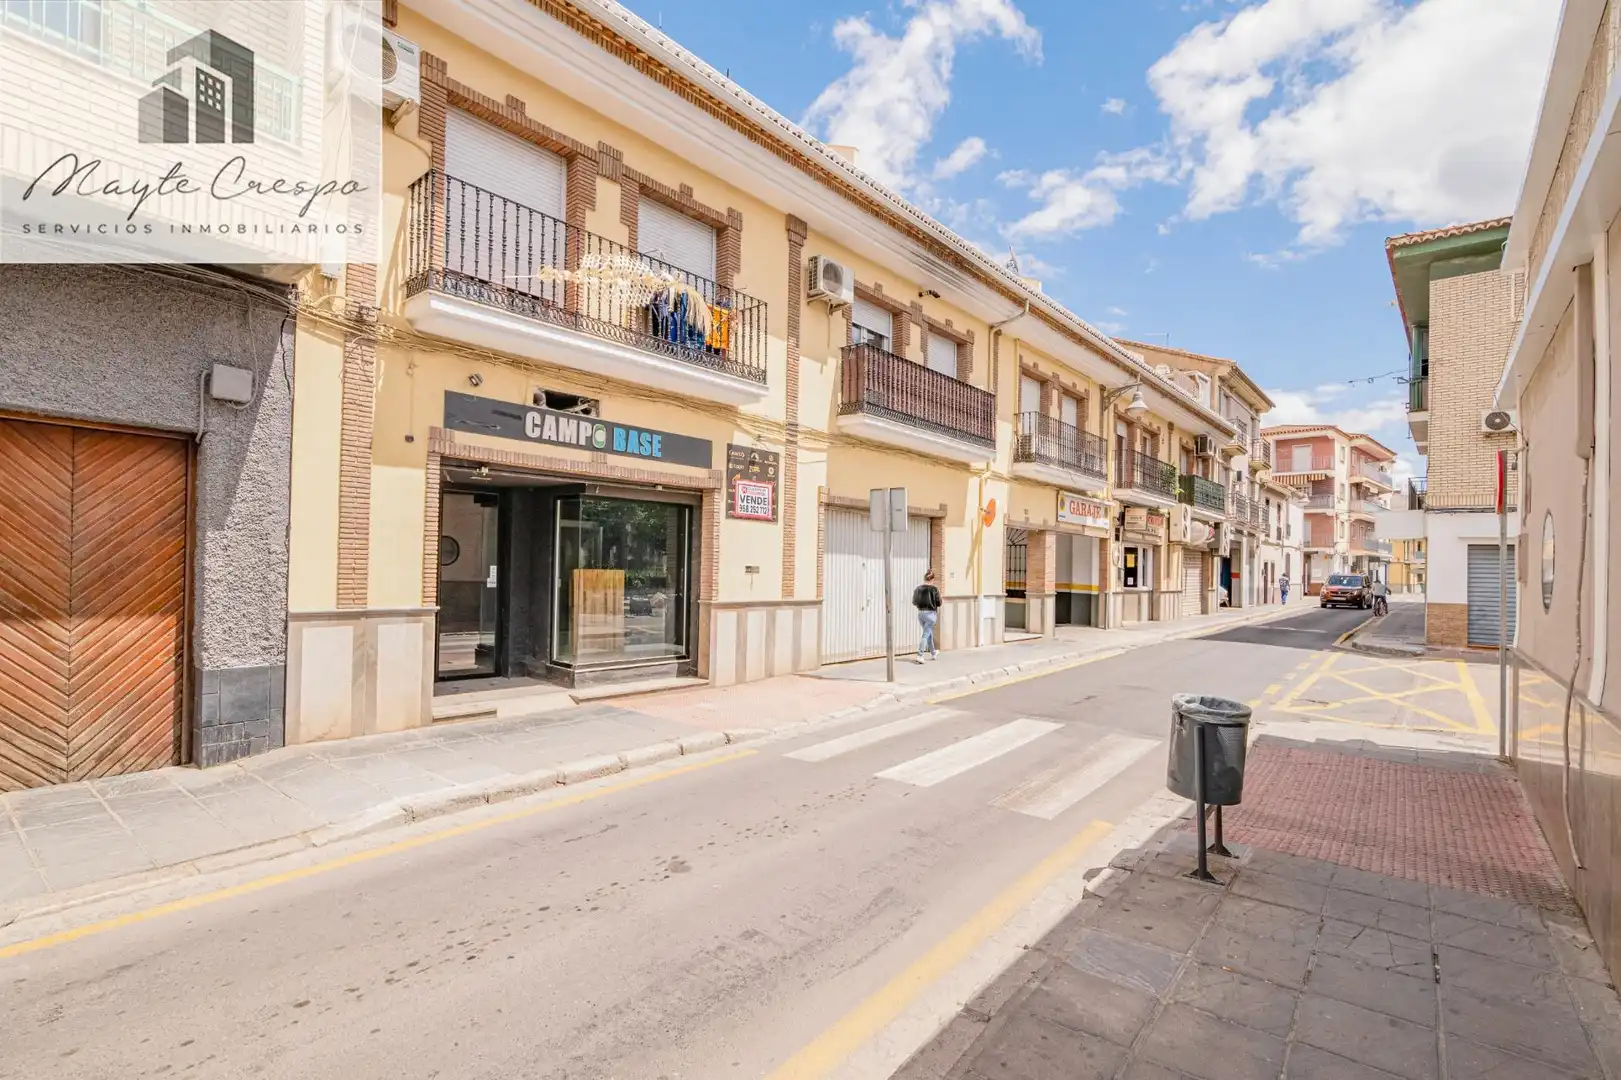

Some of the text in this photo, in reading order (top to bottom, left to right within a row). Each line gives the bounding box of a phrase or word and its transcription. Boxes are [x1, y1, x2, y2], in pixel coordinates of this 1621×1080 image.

[525, 411, 662, 458] CAMPO BASE
[740, 494, 768, 506] VENDE
[1070, 500, 1102, 520] GARAJE
